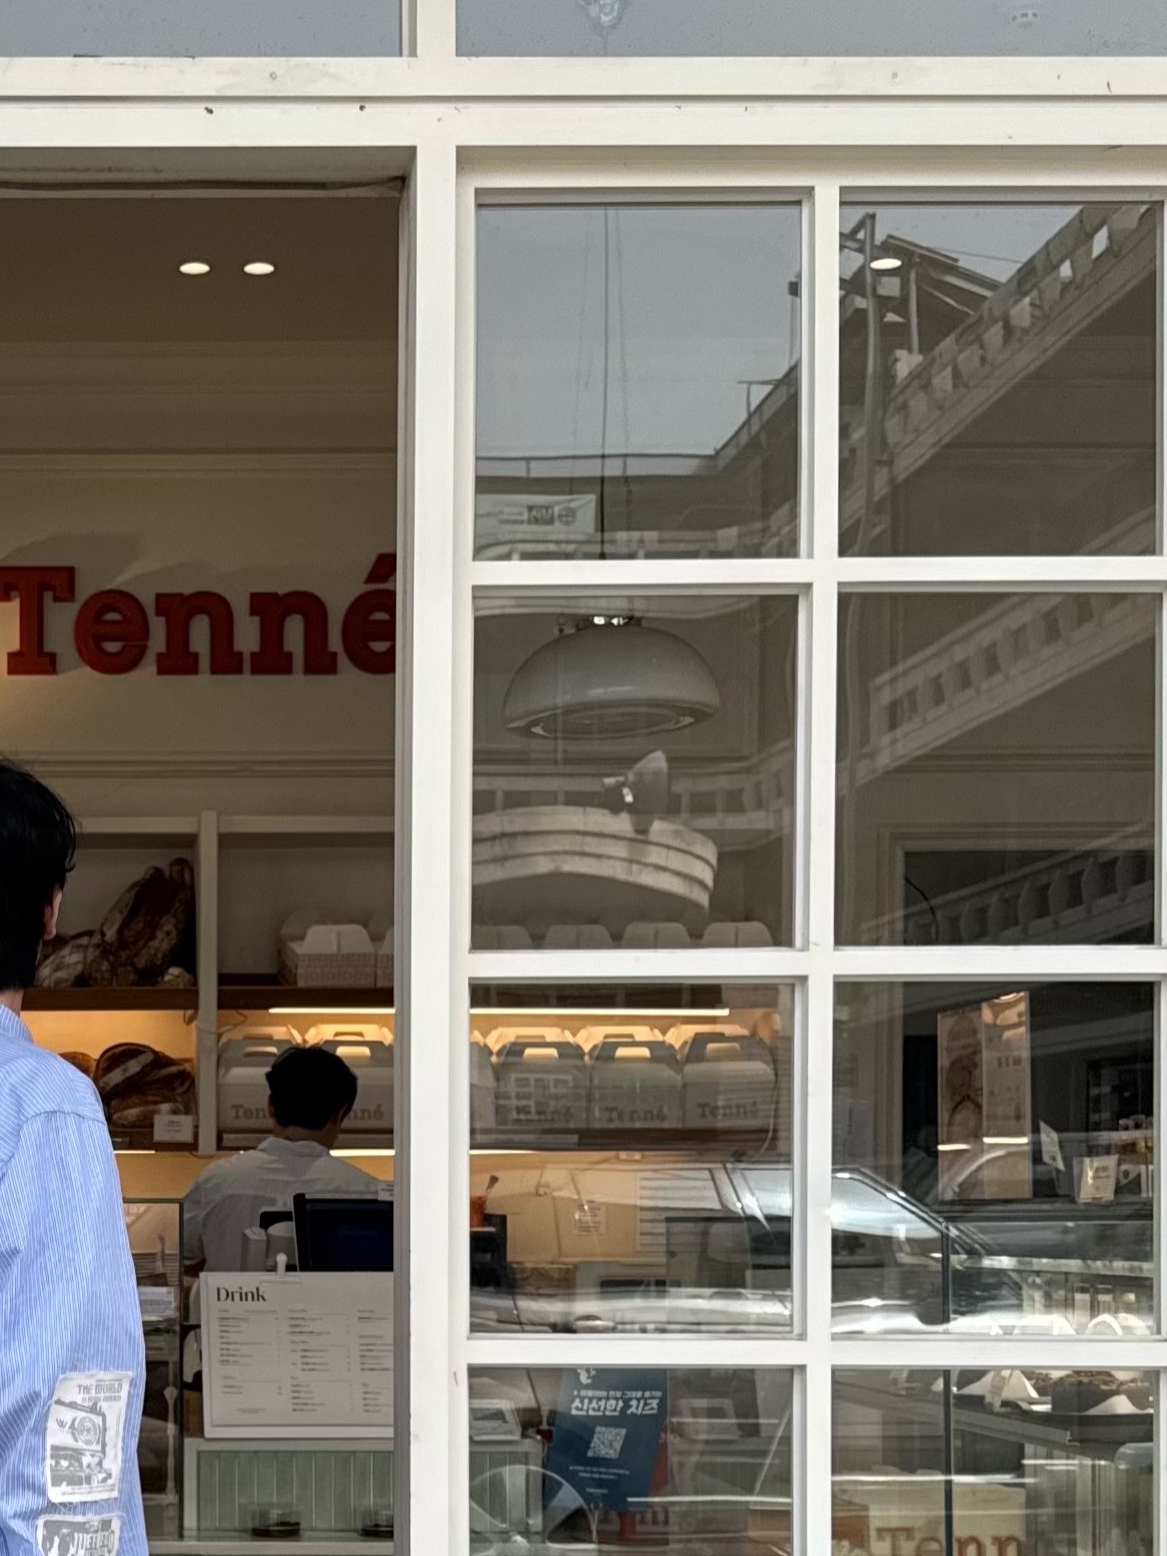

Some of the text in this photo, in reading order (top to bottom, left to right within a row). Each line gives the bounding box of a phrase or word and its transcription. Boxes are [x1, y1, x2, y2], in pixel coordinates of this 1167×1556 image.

[231, 1104, 270, 1120] Ten
[216, 1287, 267, 1302] Drink
[571, 1397, 660, 1416] 신선한 치즈
